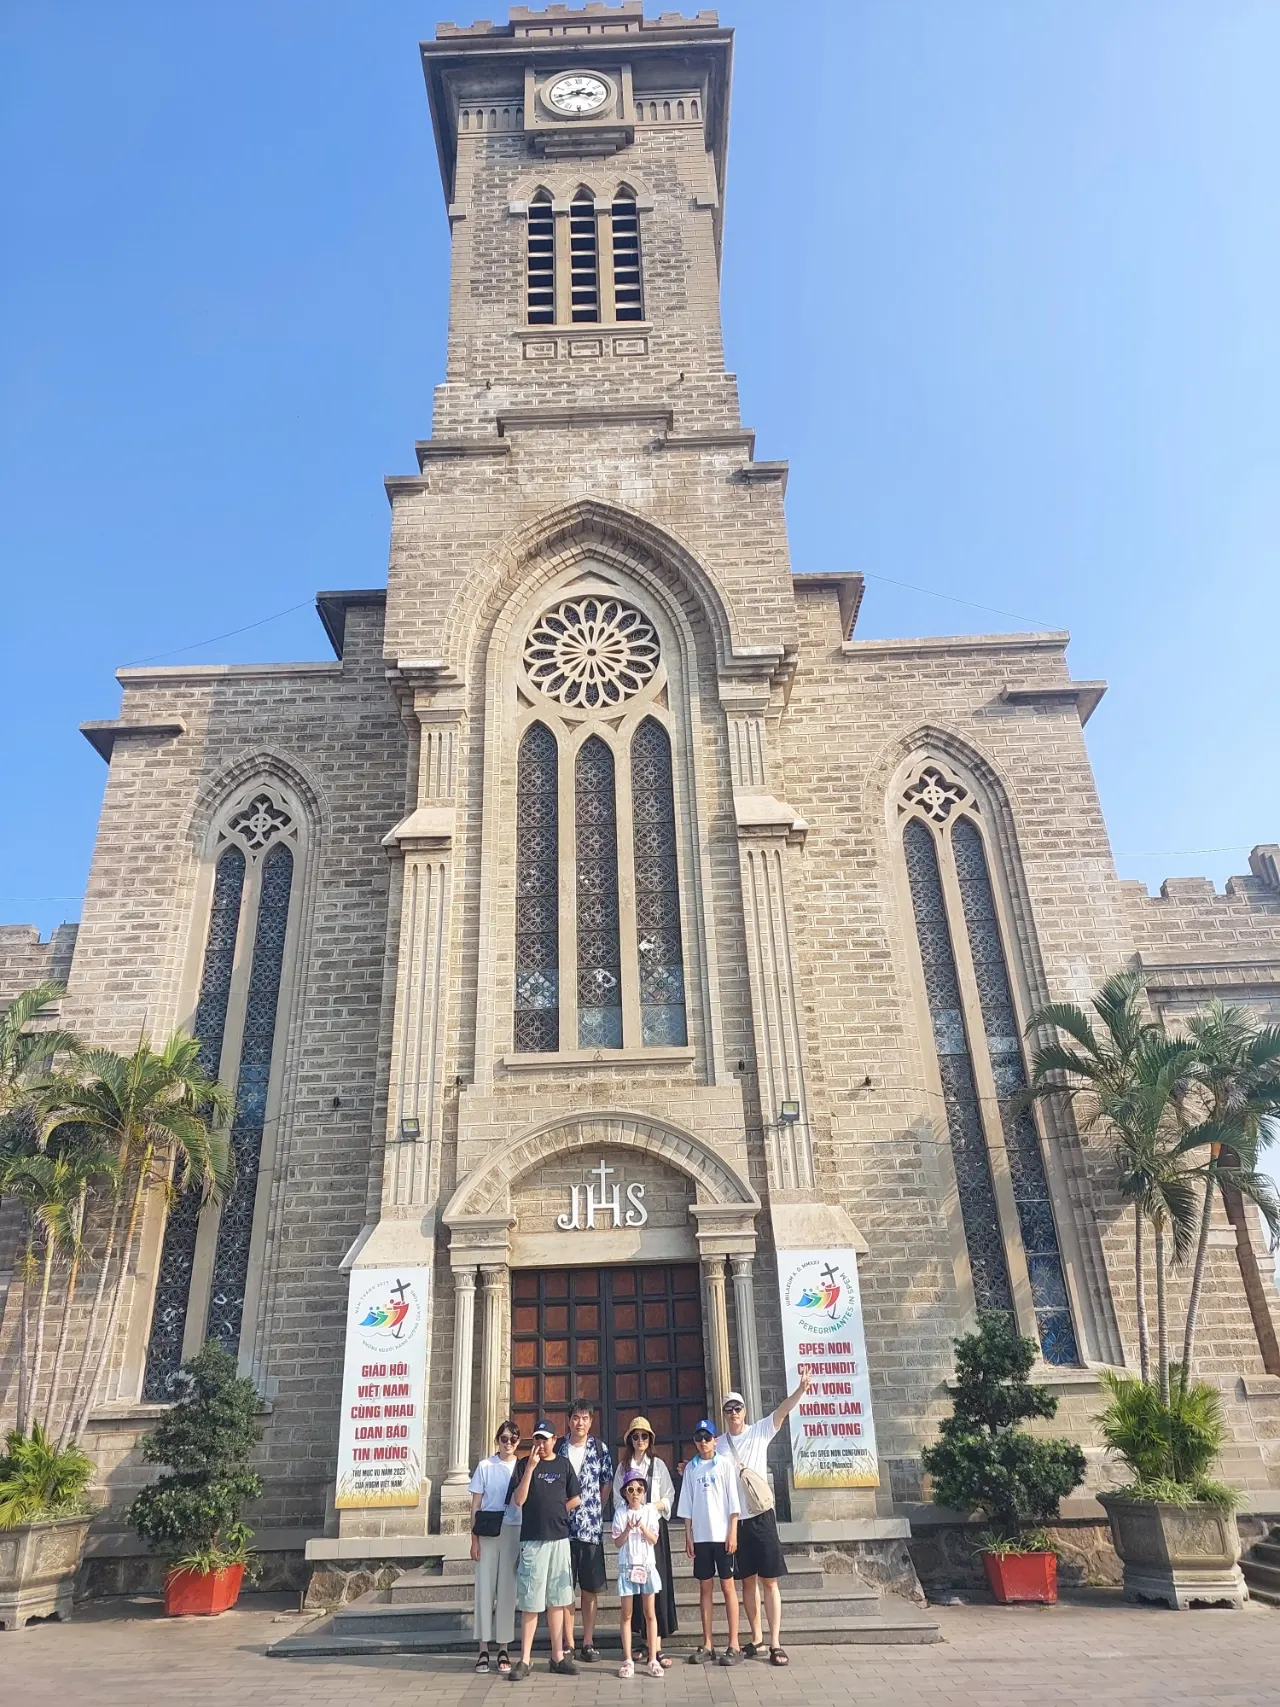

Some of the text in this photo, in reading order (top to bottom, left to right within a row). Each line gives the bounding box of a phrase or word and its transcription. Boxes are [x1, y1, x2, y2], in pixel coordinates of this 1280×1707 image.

[798, 1272, 855, 1334] PEREGRINANTES IN SPEM
[798, 1342, 851, 1355] SPES NON
[362, 1361, 408, 1380] GIÁO HỘI
[358, 1382, 409, 1400] VIỆT NAM
[822, 1382, 851, 1398] VỌNG
[351, 1404, 414, 1419] CÙNG NHAU
[799, 1400, 861, 1416] KHÔNG LÀM
[355, 1424, 407, 1440] LOAN BÁO
[803, 1420, 861, 1439] THẤT VỌNG
[352, 1445, 408, 1461] TIN MỪNG
